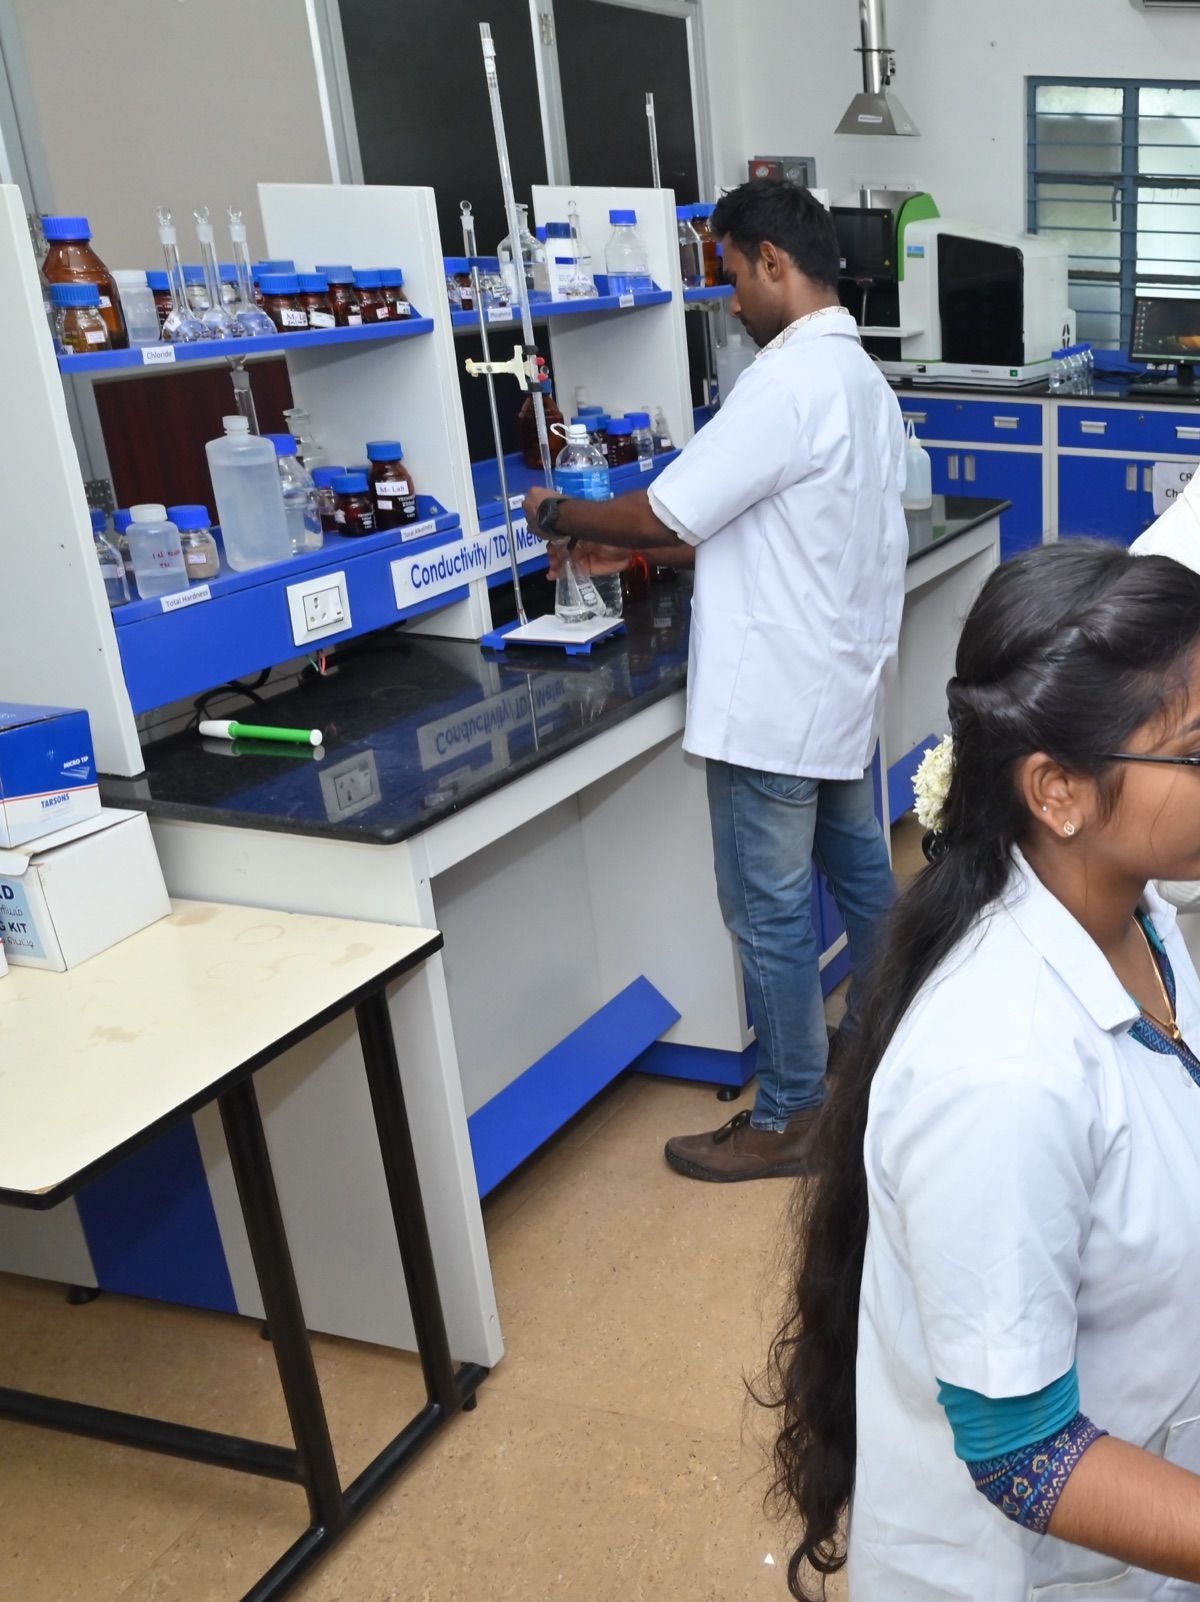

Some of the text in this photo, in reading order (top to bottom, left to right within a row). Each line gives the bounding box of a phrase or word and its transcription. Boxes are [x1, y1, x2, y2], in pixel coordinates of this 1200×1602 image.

[146, 350, 172, 360] Chloride
[1179, 472, 1193, 482] CR
[1165, 488, 1183, 498] Ch
[411, 532, 511, 589] Conductivity/TD
[166, 590, 209, 608] Total Hardness
[63, 755, 89, 769] MICRO TIP
[41, 793, 70, 809] TARSONS
[8, 921, 27, 934] KIT
